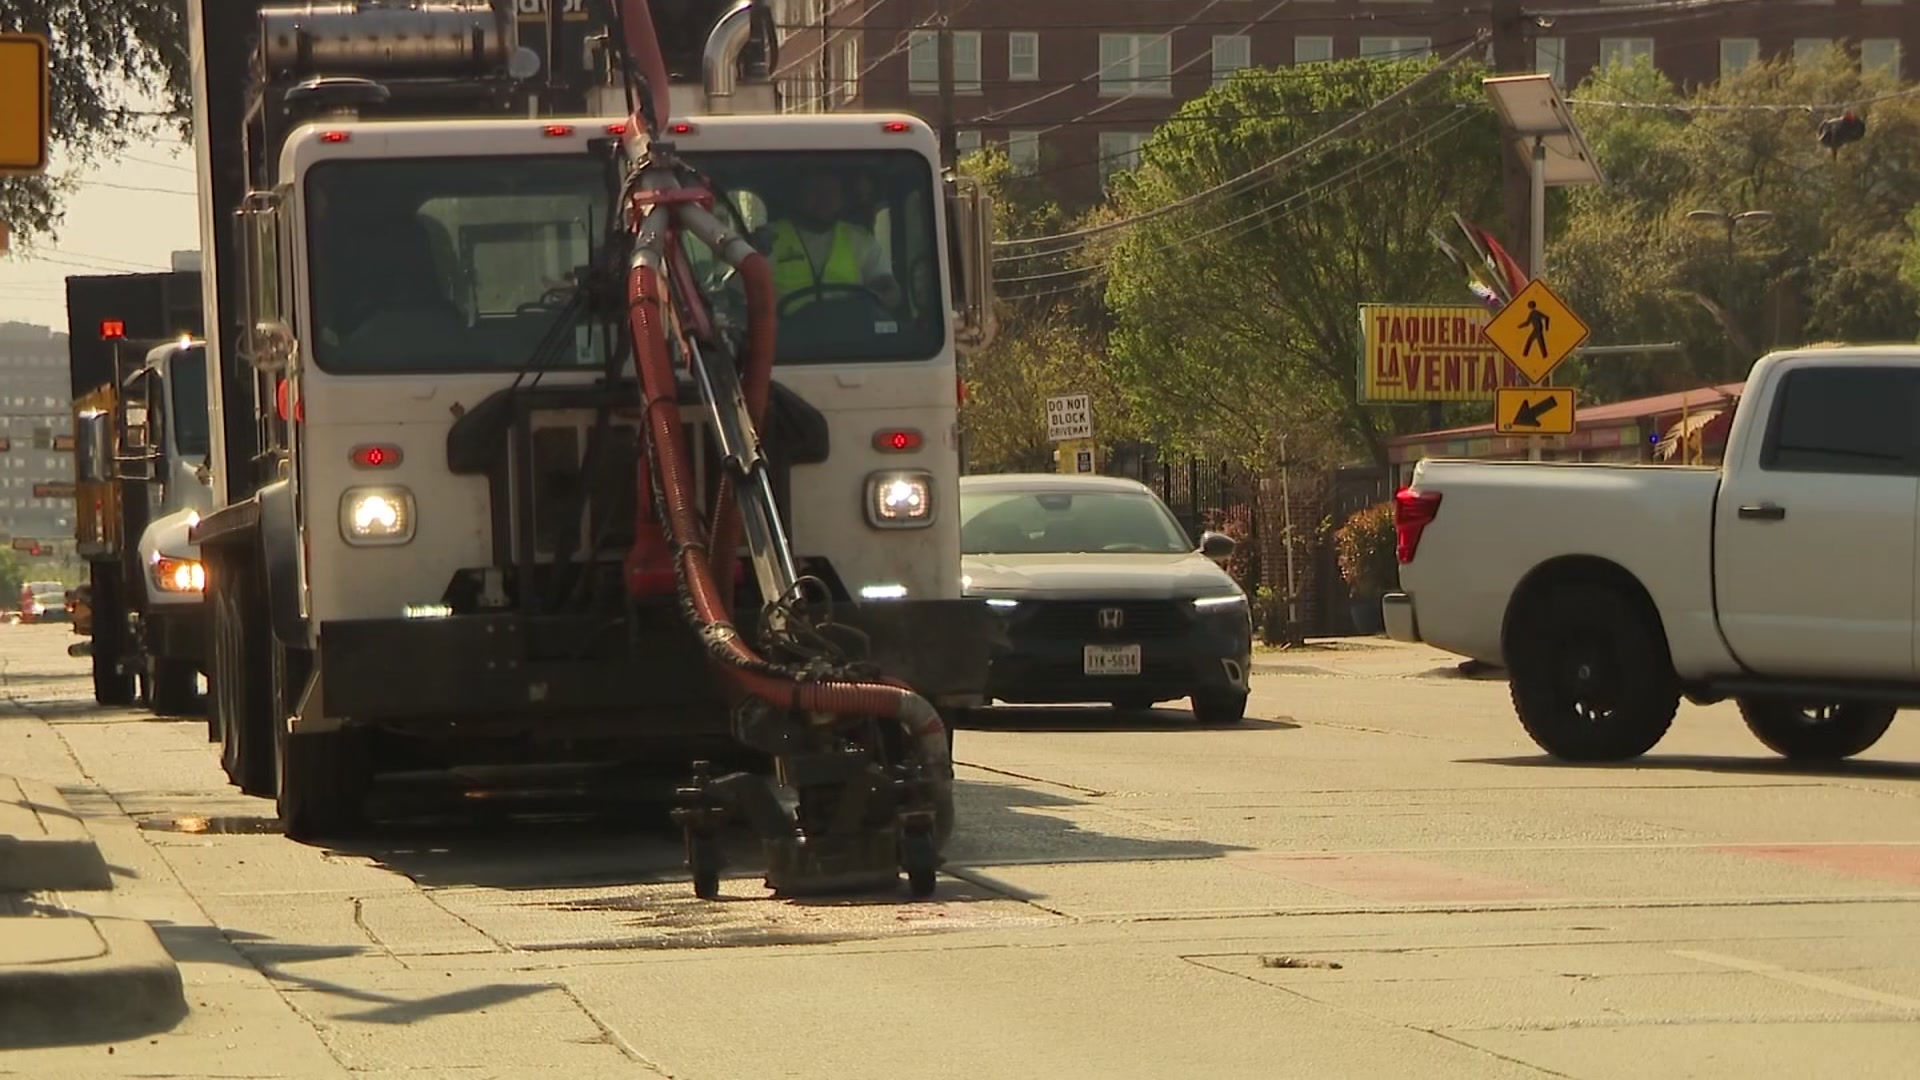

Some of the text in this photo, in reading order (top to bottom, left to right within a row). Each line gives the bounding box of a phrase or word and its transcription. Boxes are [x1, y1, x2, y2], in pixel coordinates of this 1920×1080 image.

[1377, 347, 1398, 377] LA
[1048, 398, 1086, 412] DO NOT
[1051, 412, 1086, 425] BLOCK
